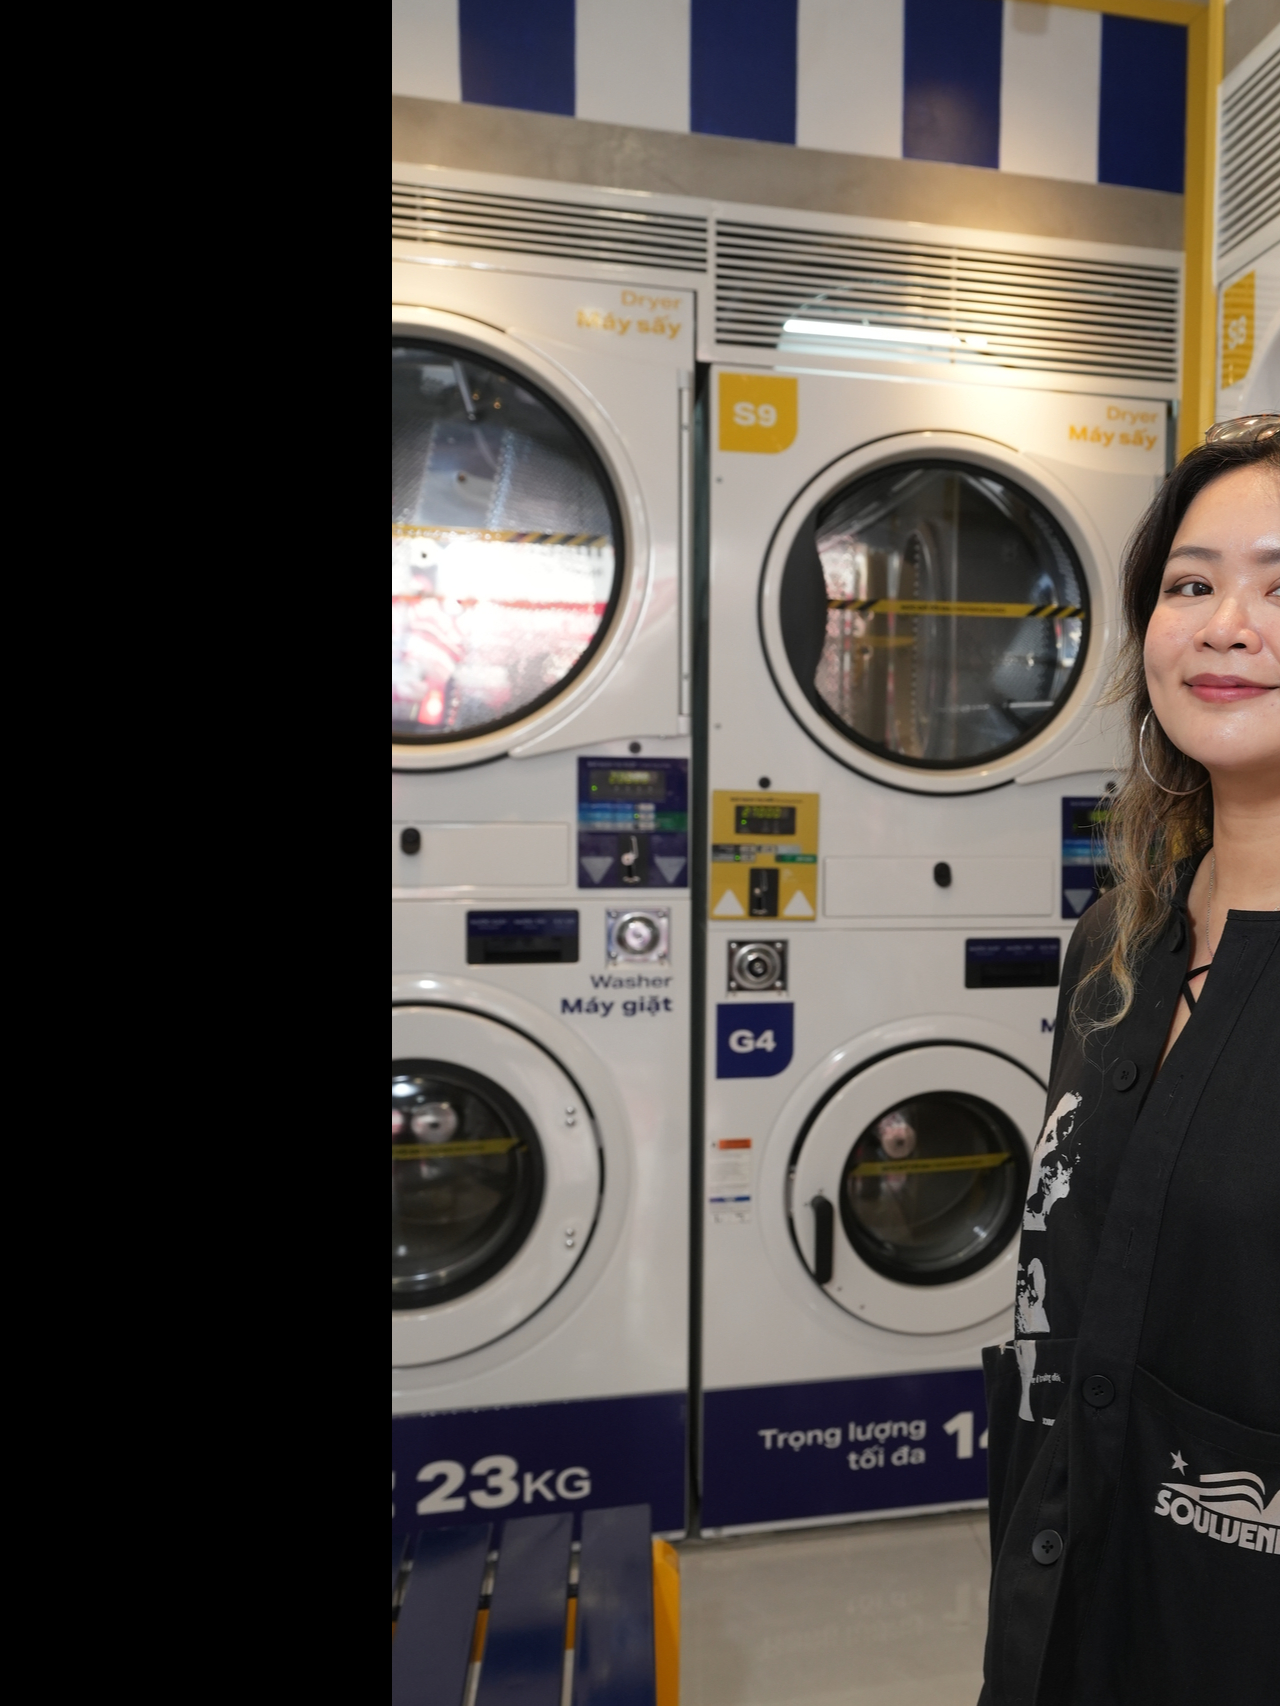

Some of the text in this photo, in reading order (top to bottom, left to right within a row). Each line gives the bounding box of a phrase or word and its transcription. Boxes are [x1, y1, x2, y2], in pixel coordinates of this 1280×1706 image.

[621, 289, 681, 312] Dryer
[733, 401, 778, 428] S9
[1107, 405, 1158, 426] Dryer
[590, 974, 674, 990] Washer
[560, 997, 615, 1018] Máy
[728, 1028, 777, 1054] G4
[757, 1419, 927, 1452] Trọng lượng
[846, 1444, 926, 1471] tối đa
